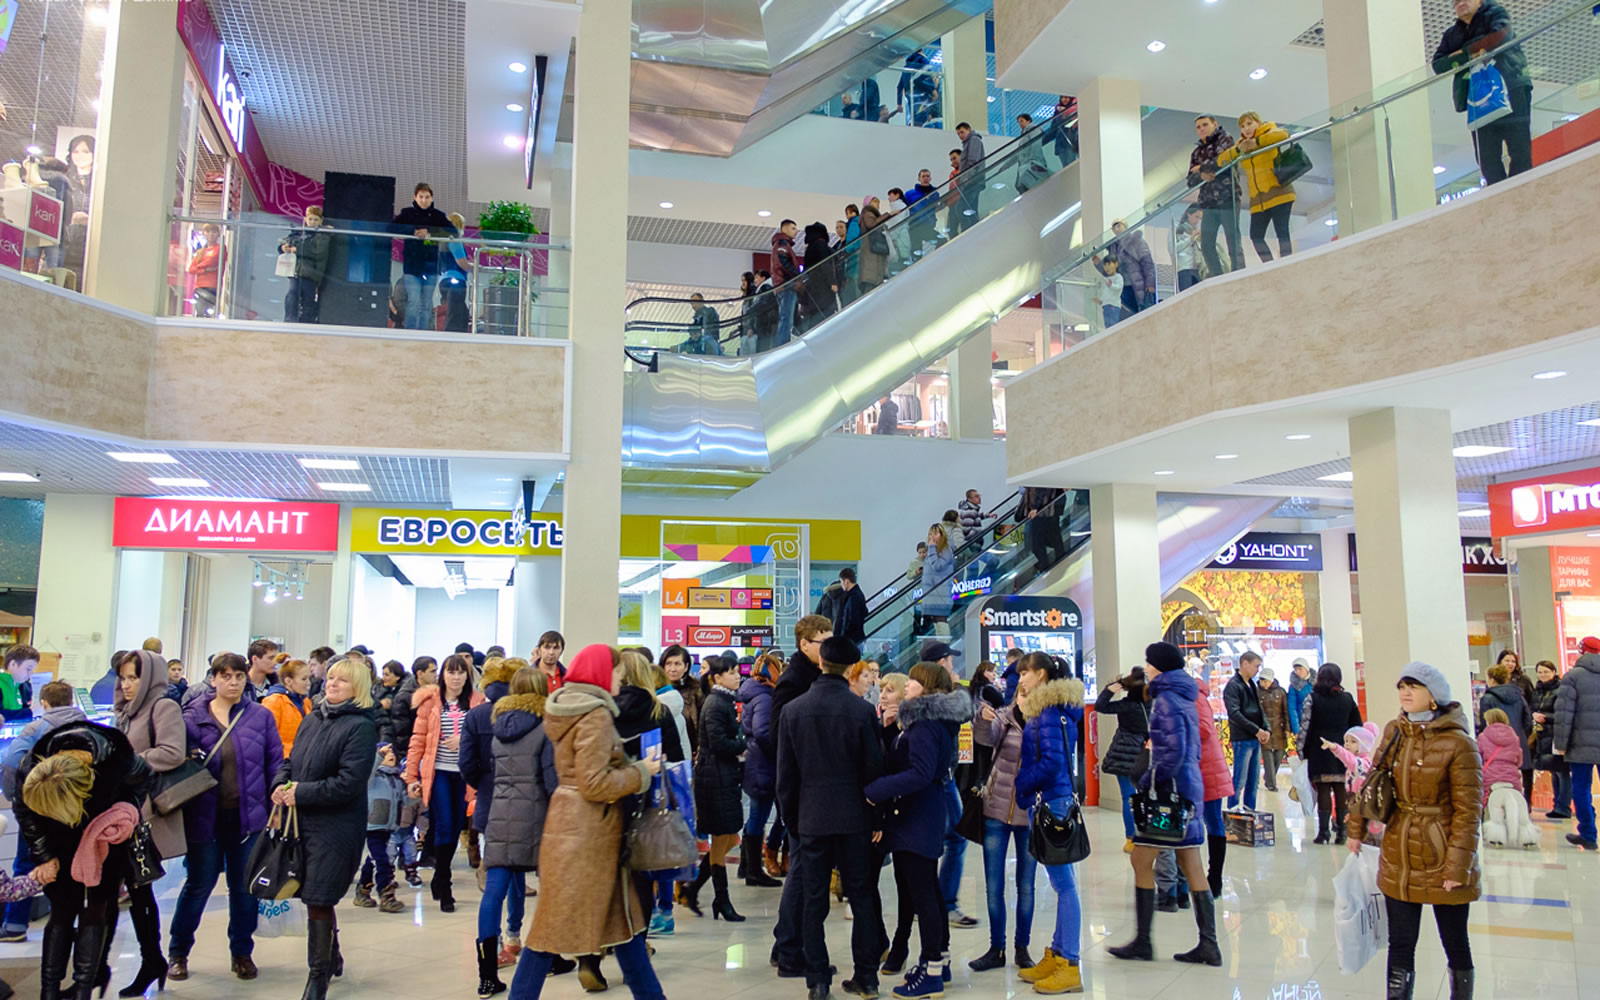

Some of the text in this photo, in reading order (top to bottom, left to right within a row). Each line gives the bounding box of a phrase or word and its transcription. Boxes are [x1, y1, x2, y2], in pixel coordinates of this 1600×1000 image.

[34, 204, 57, 225] kari
[144, 507, 309, 534] ДИАМАНТ
[1240, 543, 1308, 557] YAHONT
[1557, 555, 1592, 565] ЛУЧШИЕ
[1557, 566, 1589, 577] ТАРИФЫ
[1559, 578, 1592, 589] ДЛЯ ВАС
[666, 591, 685, 605] L4
[984, 607, 1078, 629] Smartstore
[665, 629, 683, 643] L3
